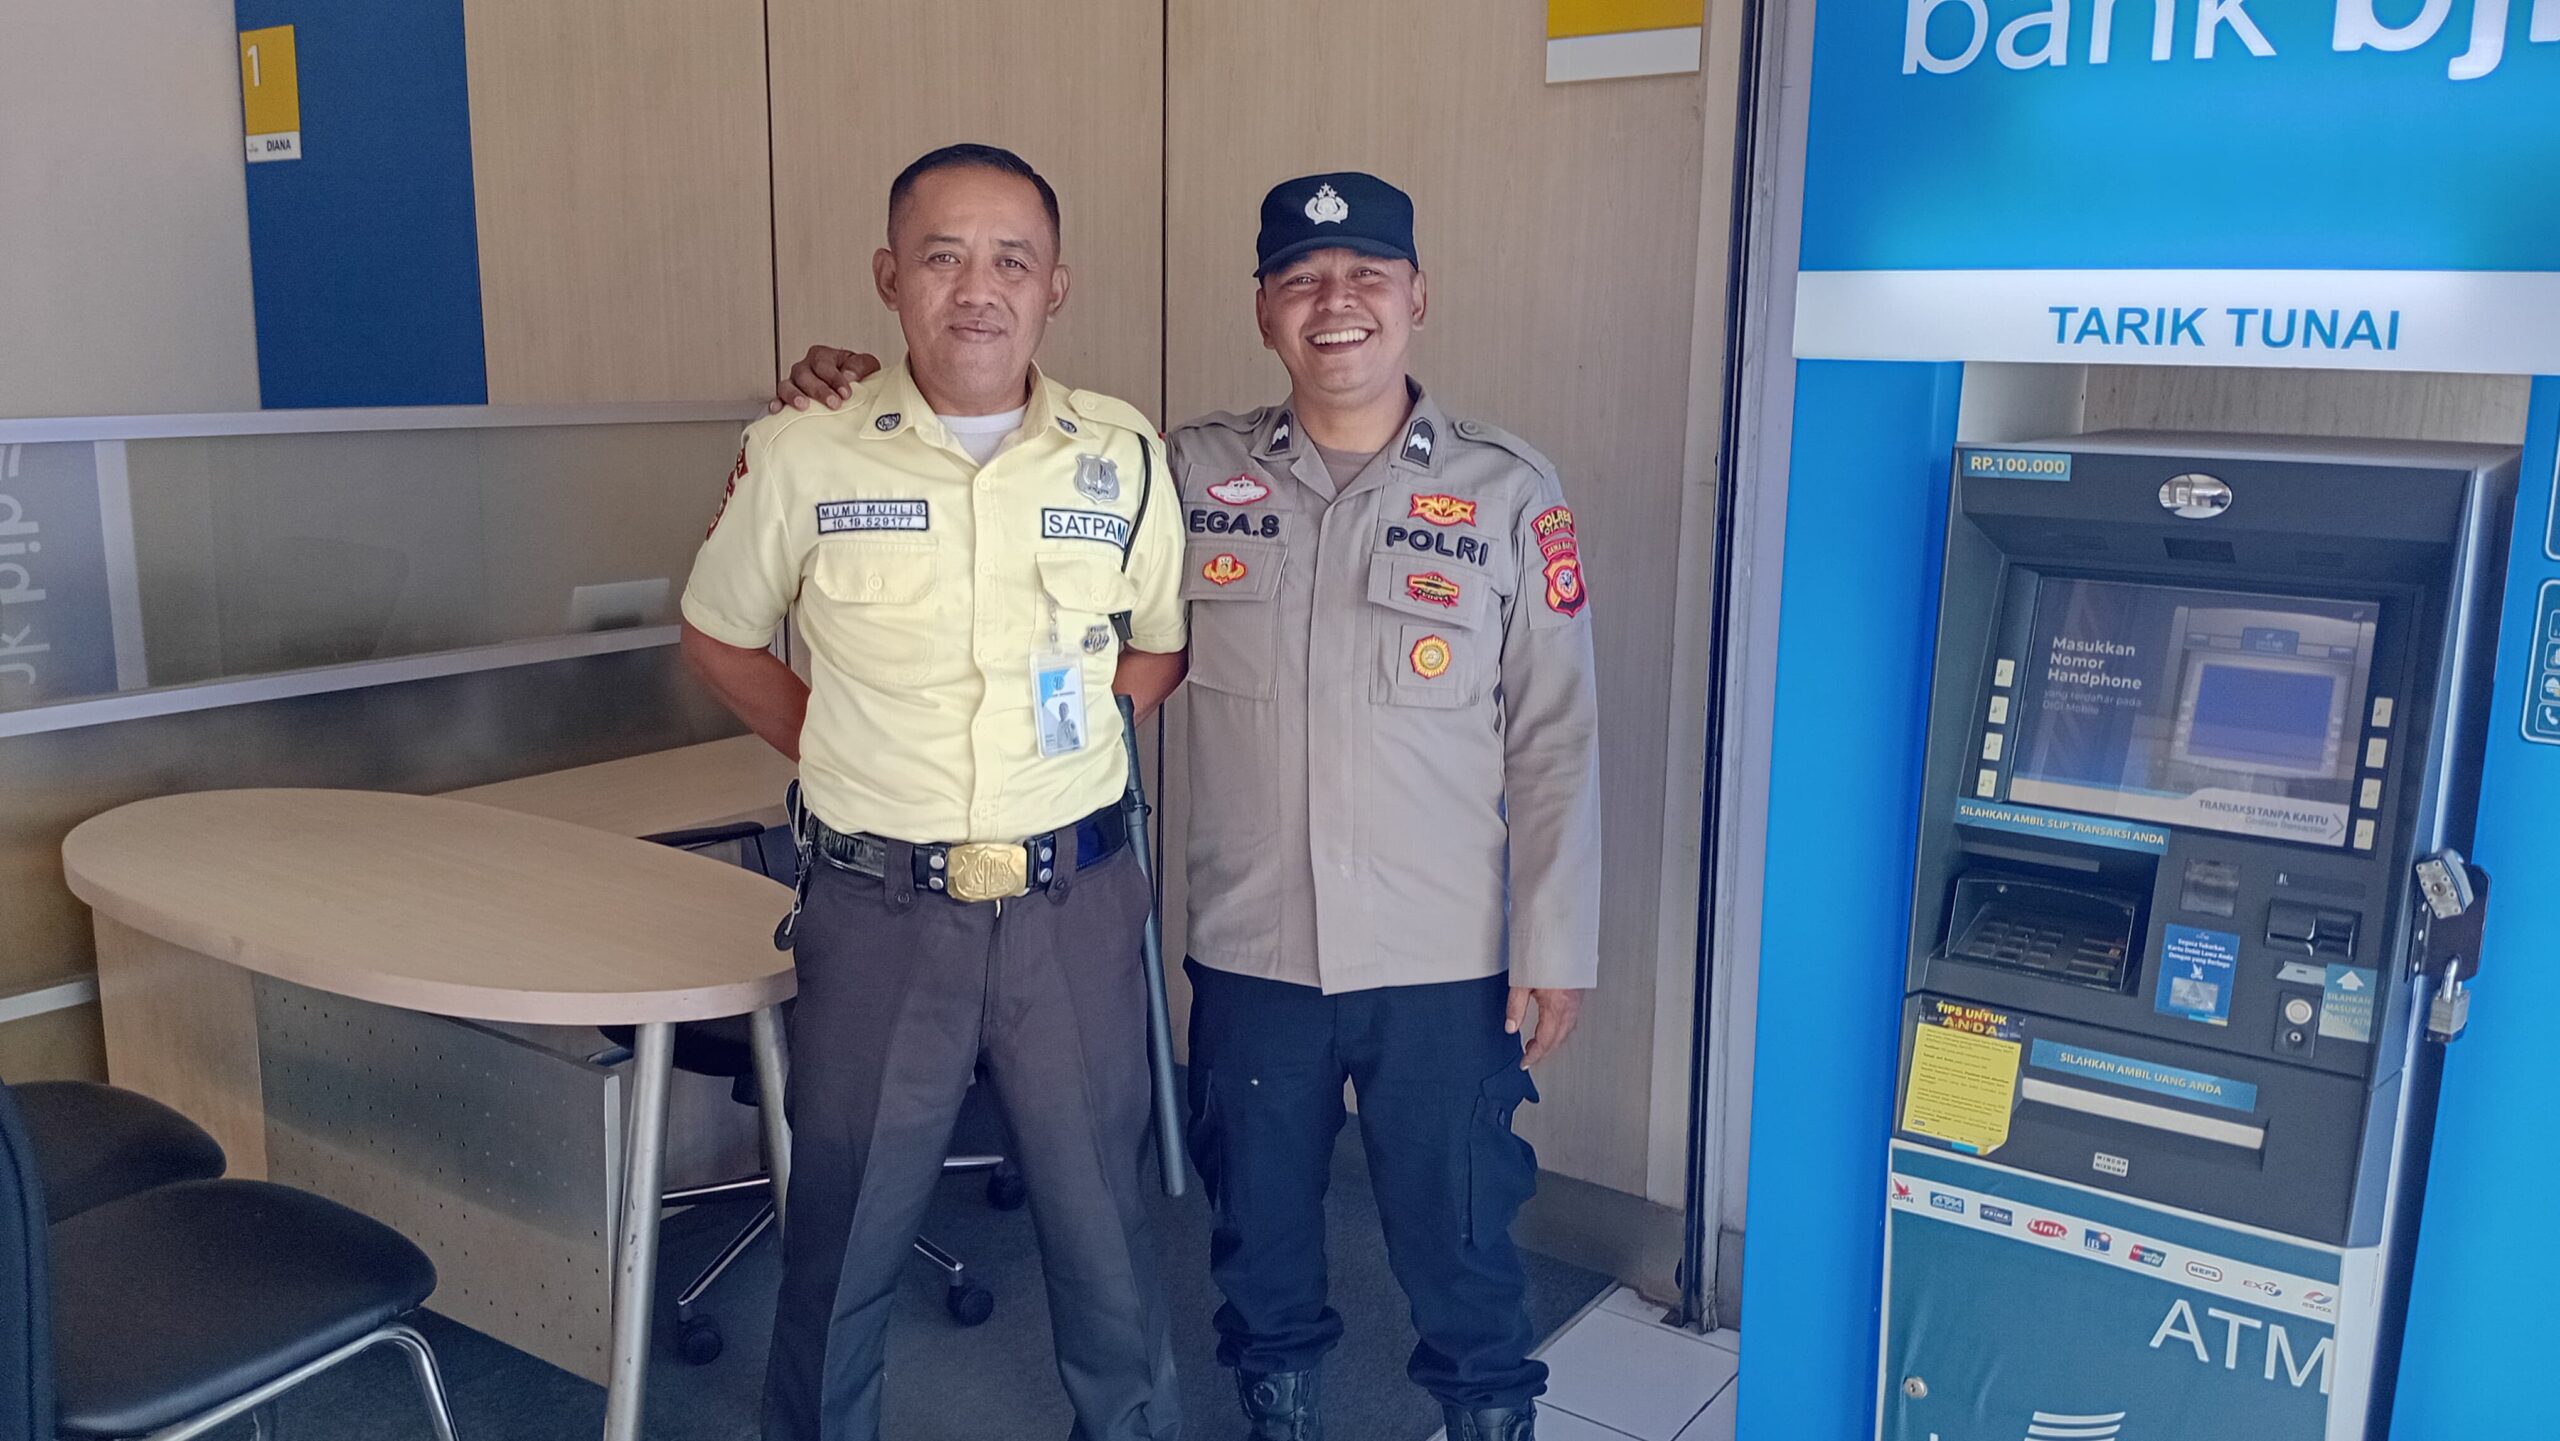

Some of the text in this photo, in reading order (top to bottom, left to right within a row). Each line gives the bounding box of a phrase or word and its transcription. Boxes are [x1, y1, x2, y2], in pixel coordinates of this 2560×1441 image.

[2331, 0, 2560, 80] bj
[247, 44, 260, 87] 1
[266, 139, 292, 152] DIANA
[2049, 306, 2400, 350] TARIK TUNAI
[1971, 456, 2065, 474] RP.100.000
[821, 504, 924, 517] MUMU MUHLIS
[1049, 514, 1126, 545] SATPAM
[1386, 526, 1489, 567] POLRI
[2052, 636, 2136, 656] Masukkan
[2050, 652, 2105, 669] Nomor
[2047, 667, 2142, 690] Handphone
[2116, 696, 2142, 707] pada
[2199, 799, 2329, 826] TRANSAKSI TANPA KARTU
[1960, 805, 2165, 845] SILAHKAN AMBIL SLIP TRANSAKSI ANDA
[1936, 1001, 2008, 1026] TIPS UNTUK
[1943, 1016, 1998, 1037] ANDA
[2060, 1052, 2222, 1096] SILAHKAN AMBIL UANG ANDA
[1983, 1209, 2009, 1220] PRIMA
[2028, 1219, 2066, 1240] Link
[2190, 1265, 2218, 1278] MEPS
[2149, 1299, 2334, 1395] ATM
